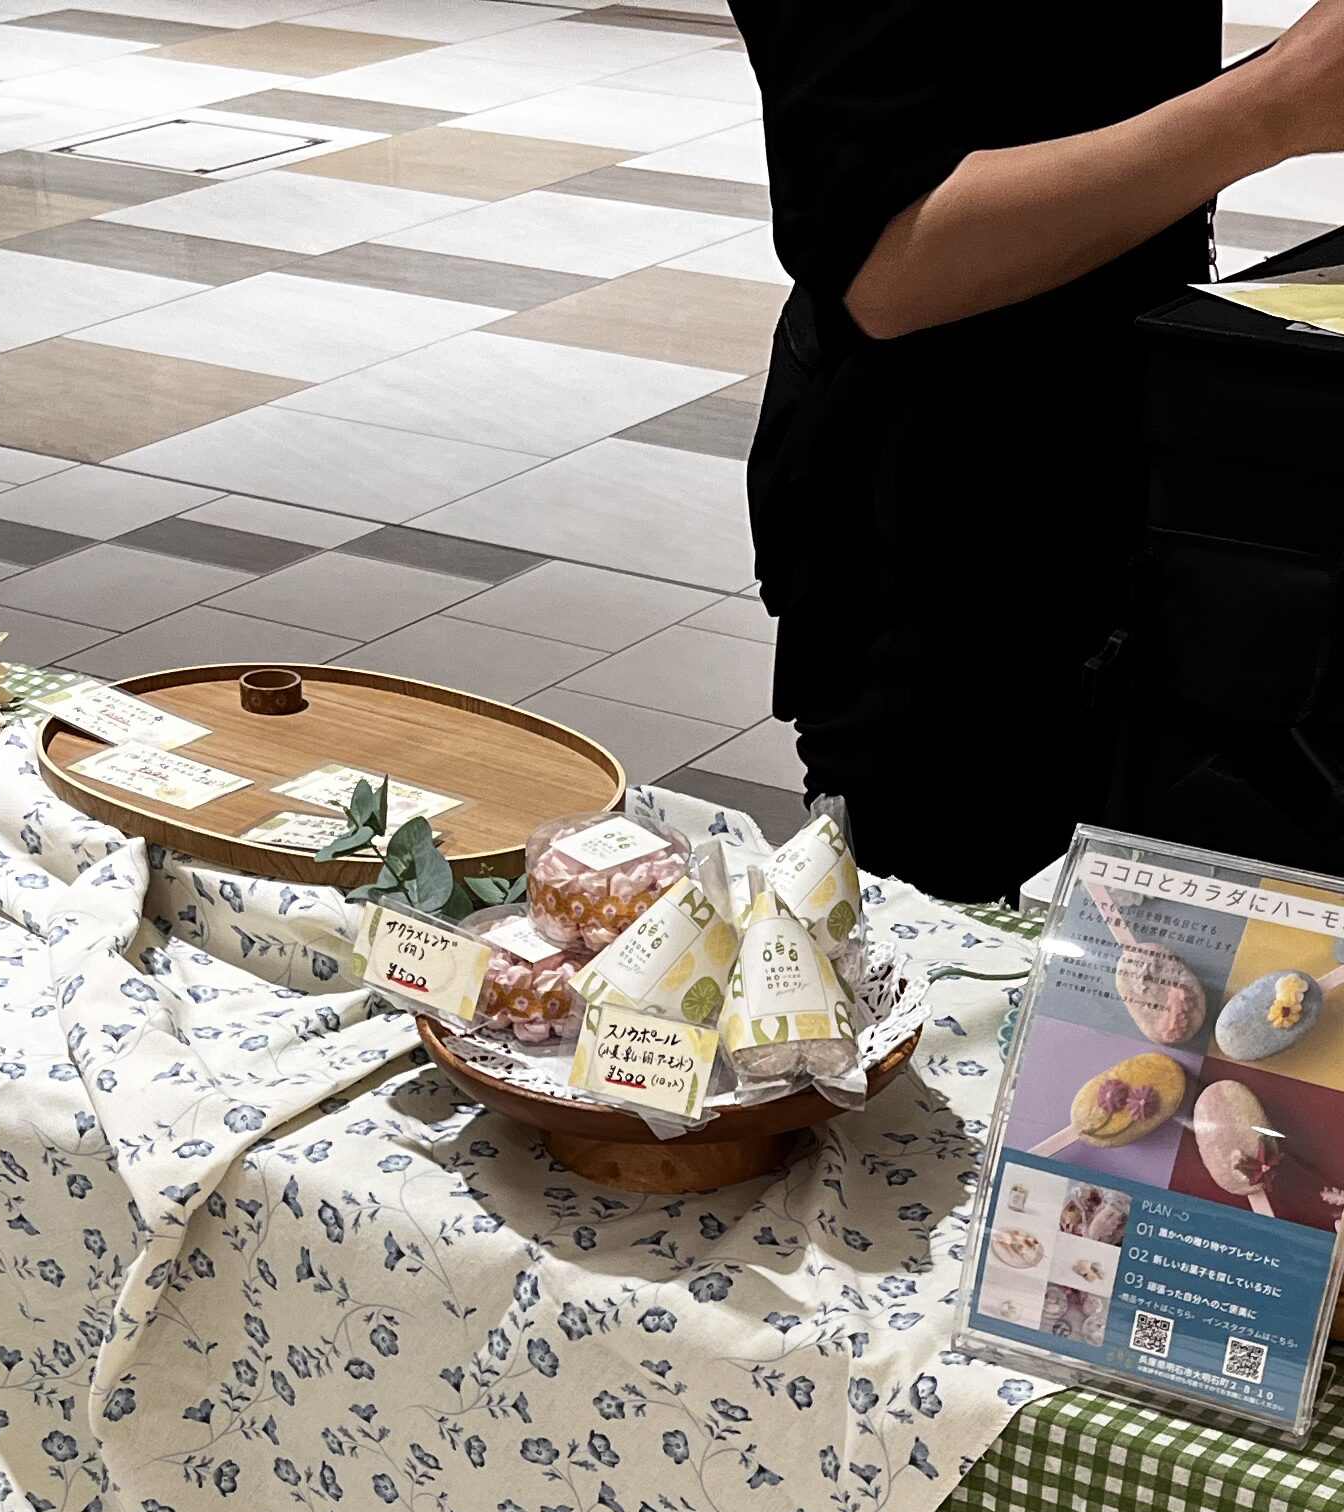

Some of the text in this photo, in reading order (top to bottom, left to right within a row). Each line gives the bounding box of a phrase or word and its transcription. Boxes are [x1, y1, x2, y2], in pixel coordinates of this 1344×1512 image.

[386, 962, 427, 988] ¥500
[606, 1064, 646, 1086] ¥500
[1142, 1200, 1172, 1218] PLAN
[1136, 1222, 1154, 1238] 01
[1128, 1247, 1149, 1264] 02
[1124, 1272, 1144, 1290] 03
